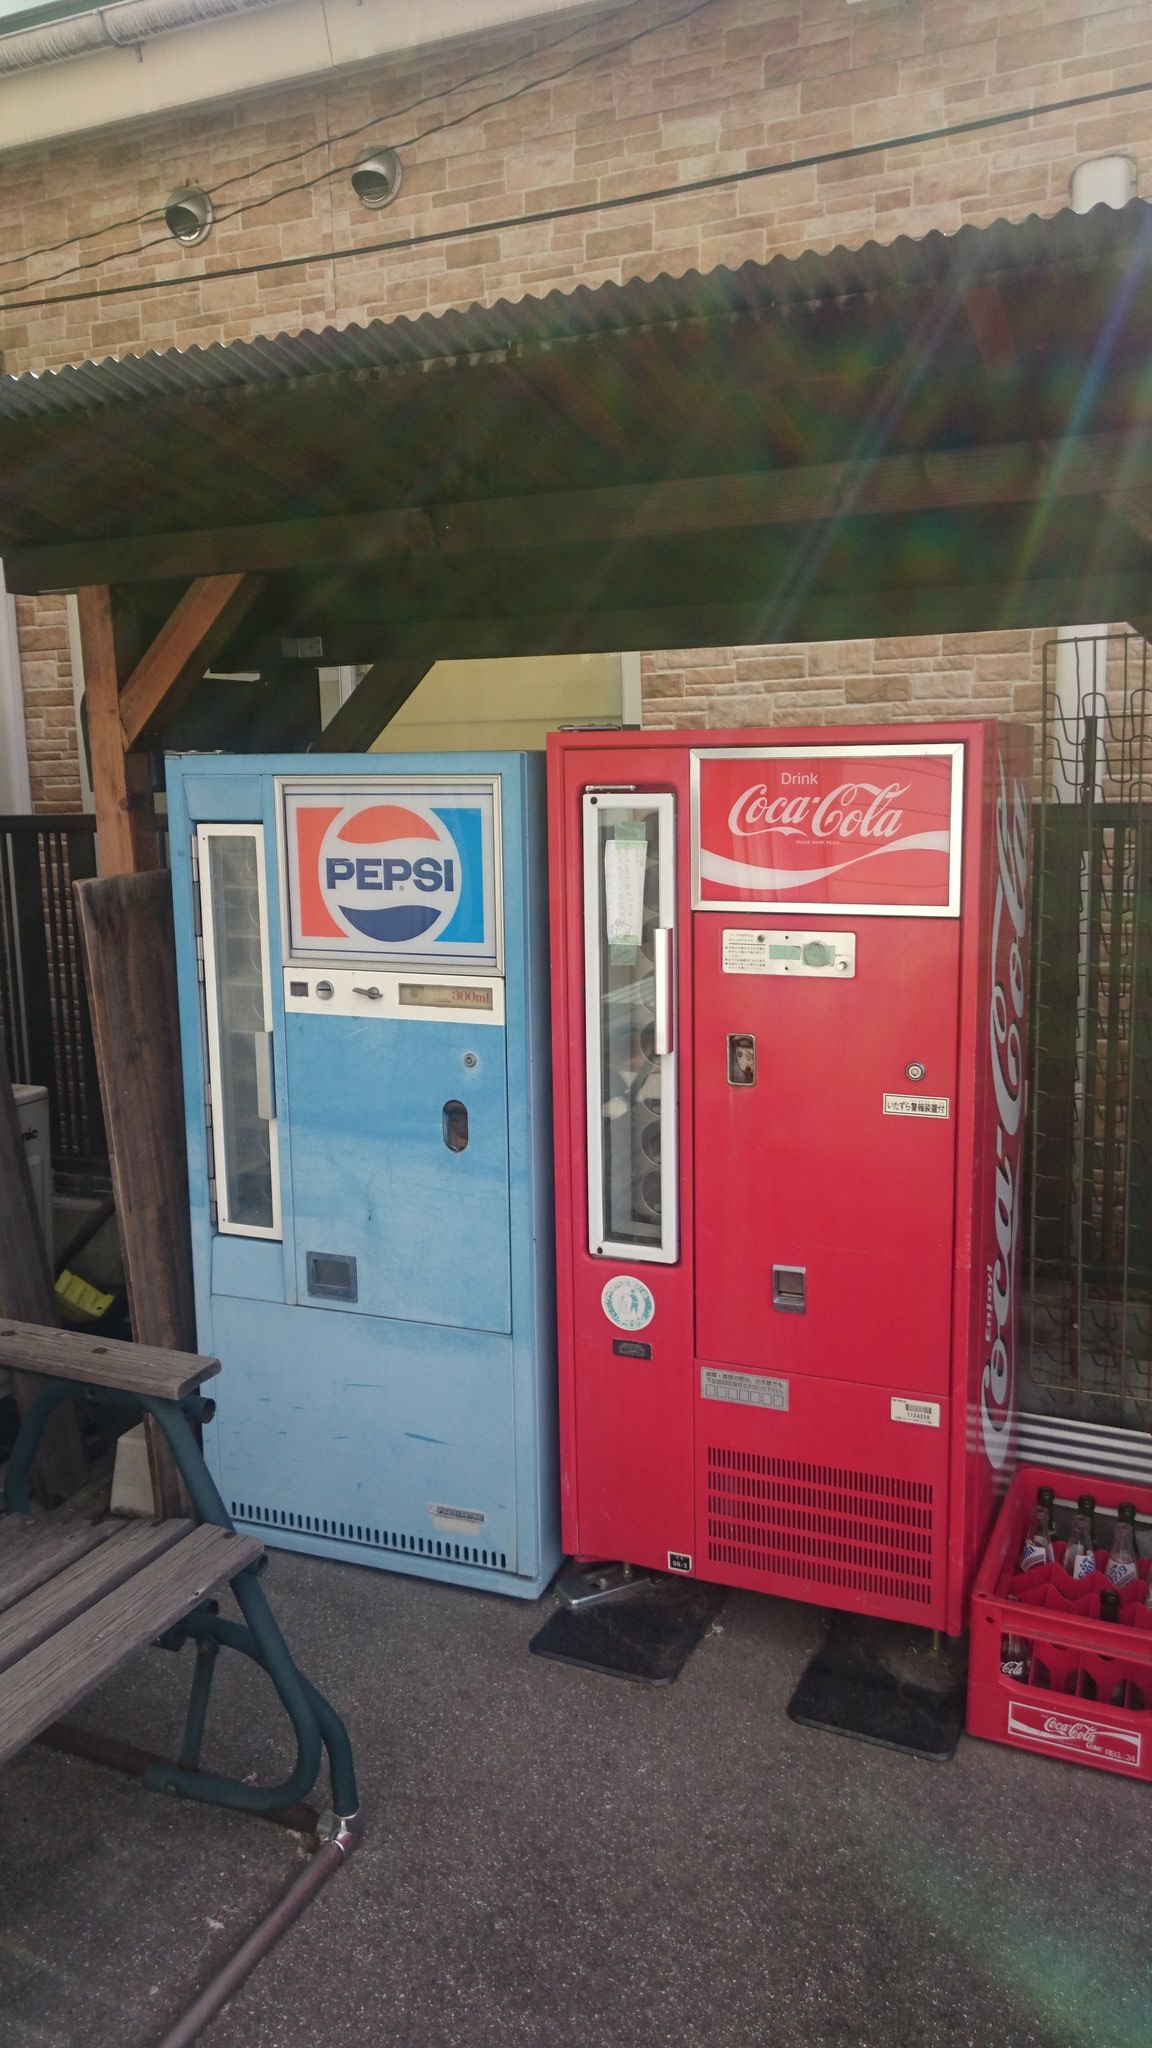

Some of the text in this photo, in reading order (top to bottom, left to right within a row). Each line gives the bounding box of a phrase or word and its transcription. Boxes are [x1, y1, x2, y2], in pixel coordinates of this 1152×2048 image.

[781, 772, 819, 786] Drink
[727, 782, 913, 838] Coca-Cola
[325, 856, 455, 892] PEPSI
[451, 989, 490, 1004] 300ml
[886, 1101, 945, 1114] いたずら警報装置付
[981, 746, 1029, 1468] Coca-Cola
[1043, 1716, 1097, 1742] Coca-Cola
